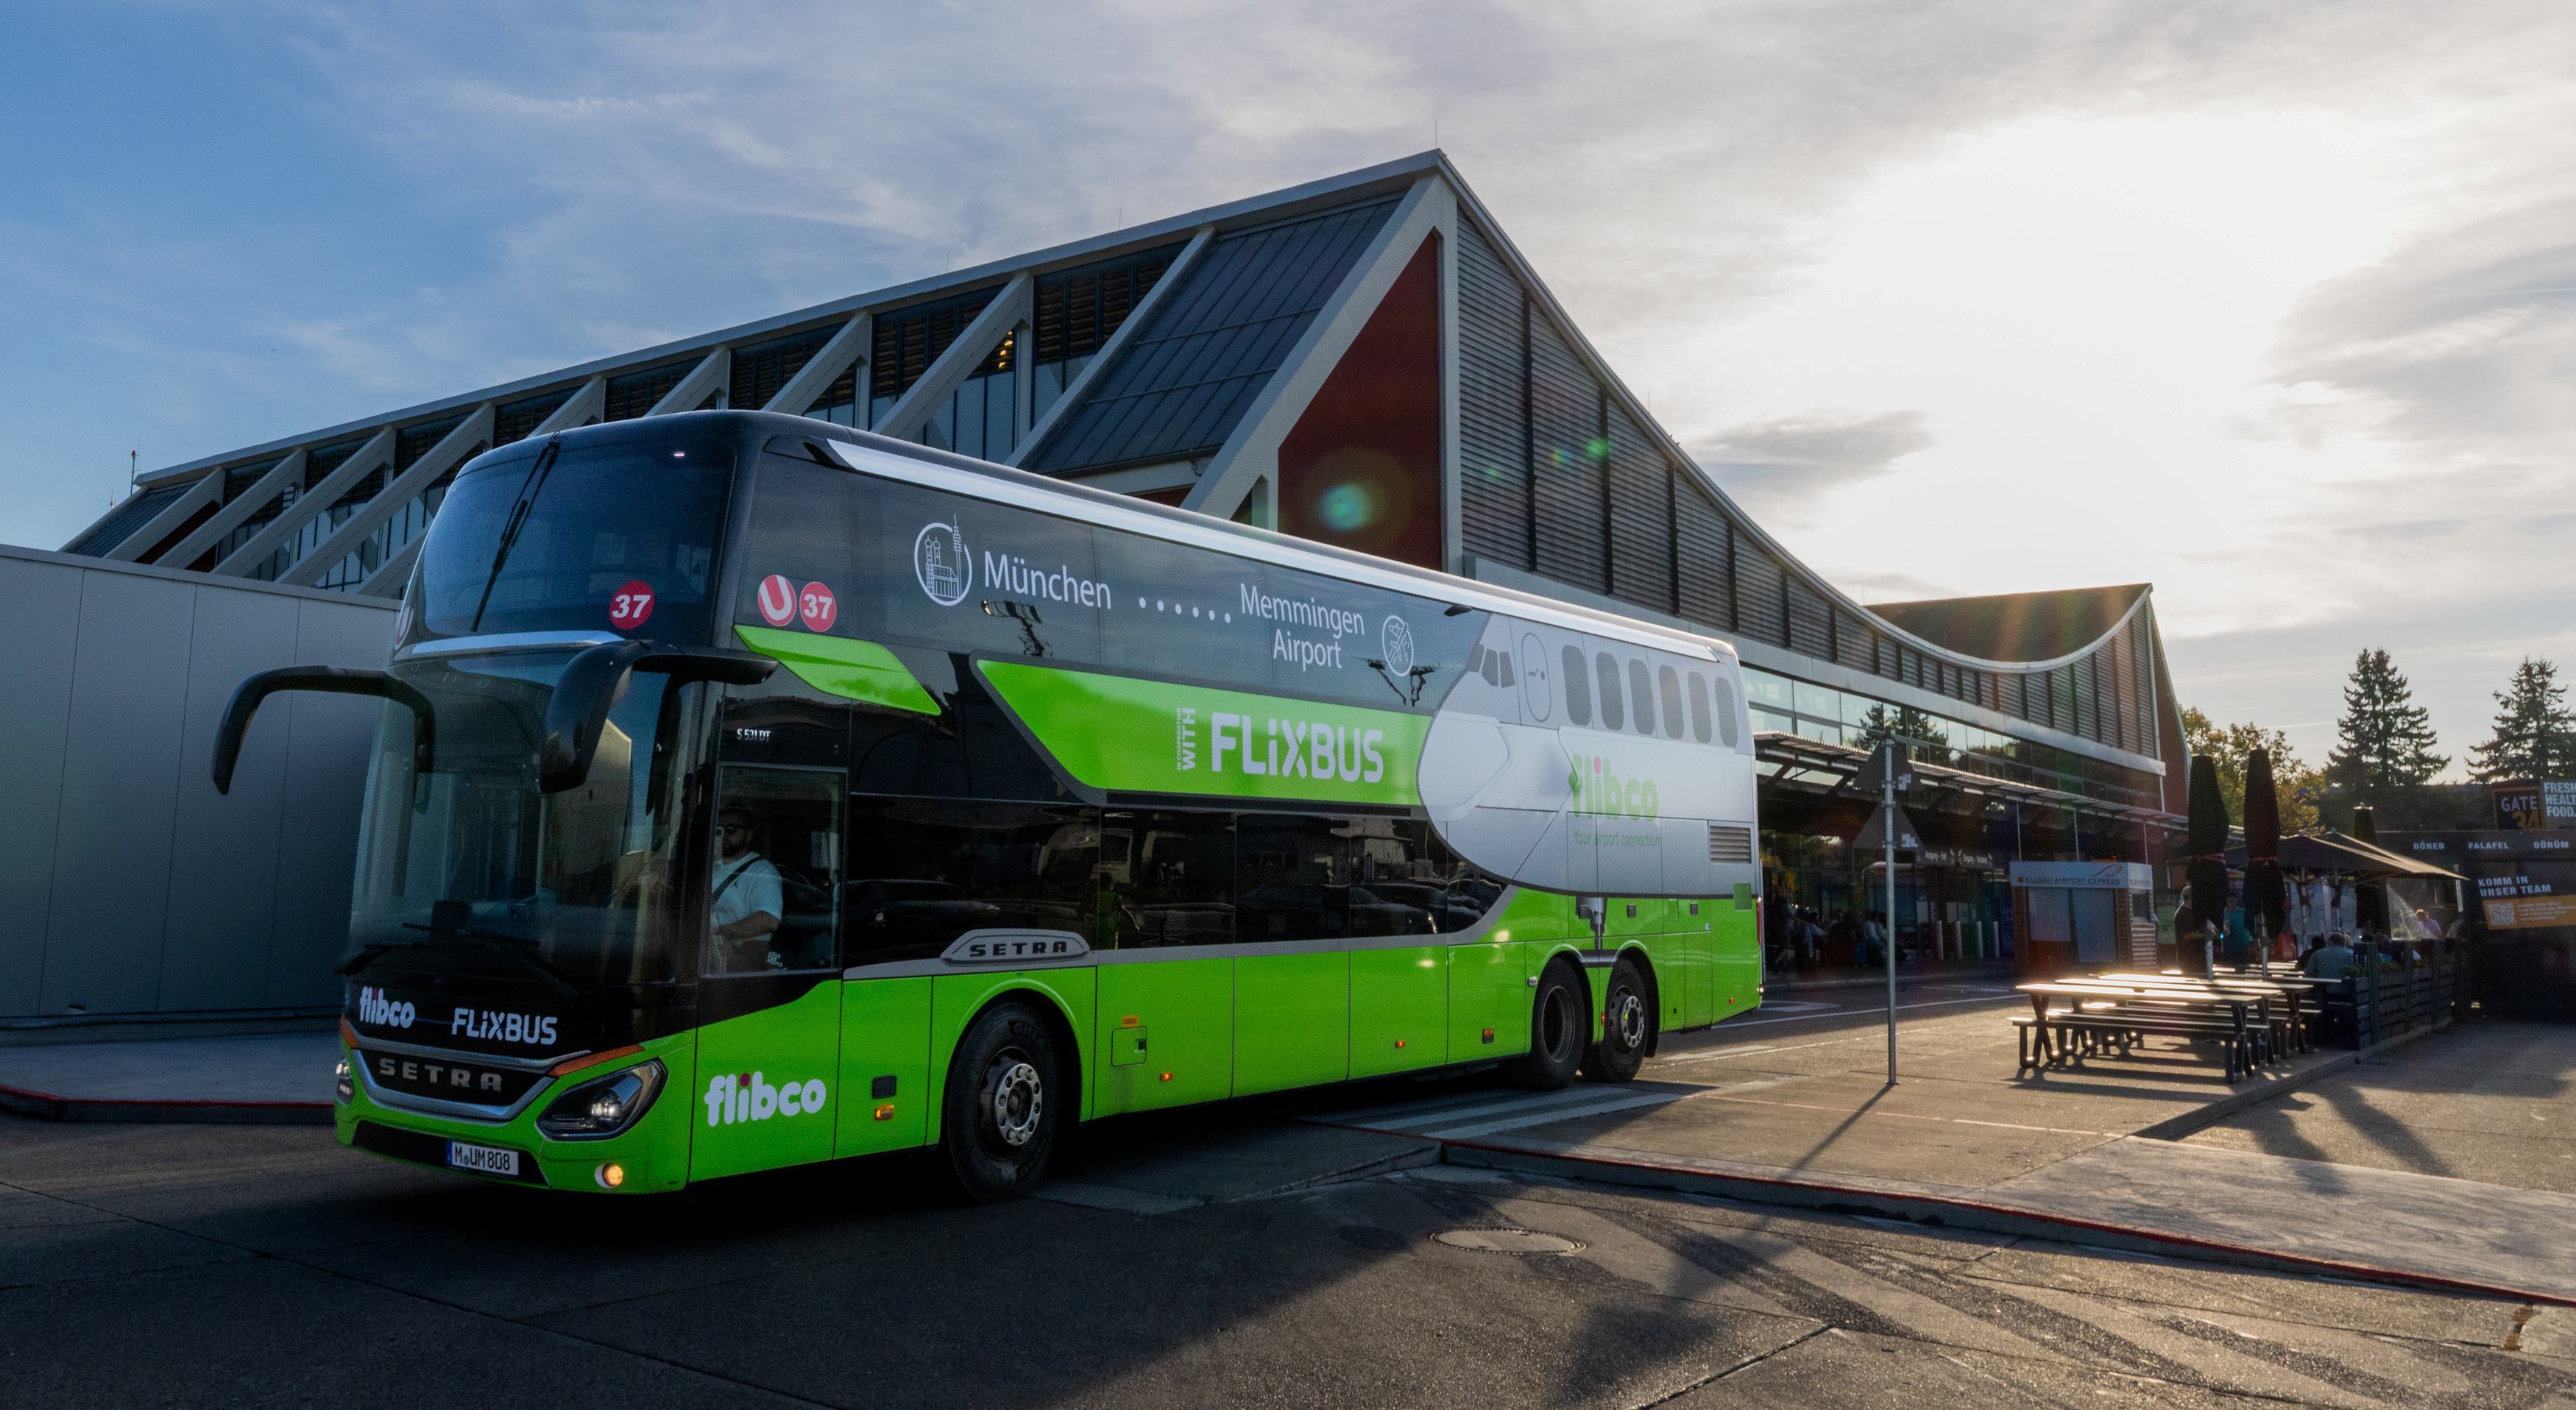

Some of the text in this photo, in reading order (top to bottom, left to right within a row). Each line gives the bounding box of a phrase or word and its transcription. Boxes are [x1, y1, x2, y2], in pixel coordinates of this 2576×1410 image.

[984, 550, 1112, 610] München
[612, 594, 651, 619] 37
[804, 593, 832, 620] 37
[1240, 582, 1365, 640] Memmingen
[1273, 628, 1342, 672] Airport
[1182, 707, 1196, 770] WITH
[1568, 754, 1659, 821] flibco
[2544, 782, 2576, 793] FRESH
[2501, 796, 2538, 812] GATE
[1573, 829, 1660, 848] Your airport connection
[2413, 841, 2445, 850] DÖNER
[2469, 842, 2509, 850] FALAFEL
[2533, 840, 2569, 849] DÜRÜM
[2088, 877, 2120, 885] EXPRESS
[2477, 875, 2529, 887] KOMM IN
[2480, 884, 2552, 897] UNSER TEAM
[970, 941, 1066, 957] SETRA
[359, 986, 415, 1029] flibco
[379, 1058, 502, 1092] SETRA
[704, 1071, 827, 1127] flibco
[455, 1146, 463, 1163] M
[487, 1151, 511, 1171] 808
